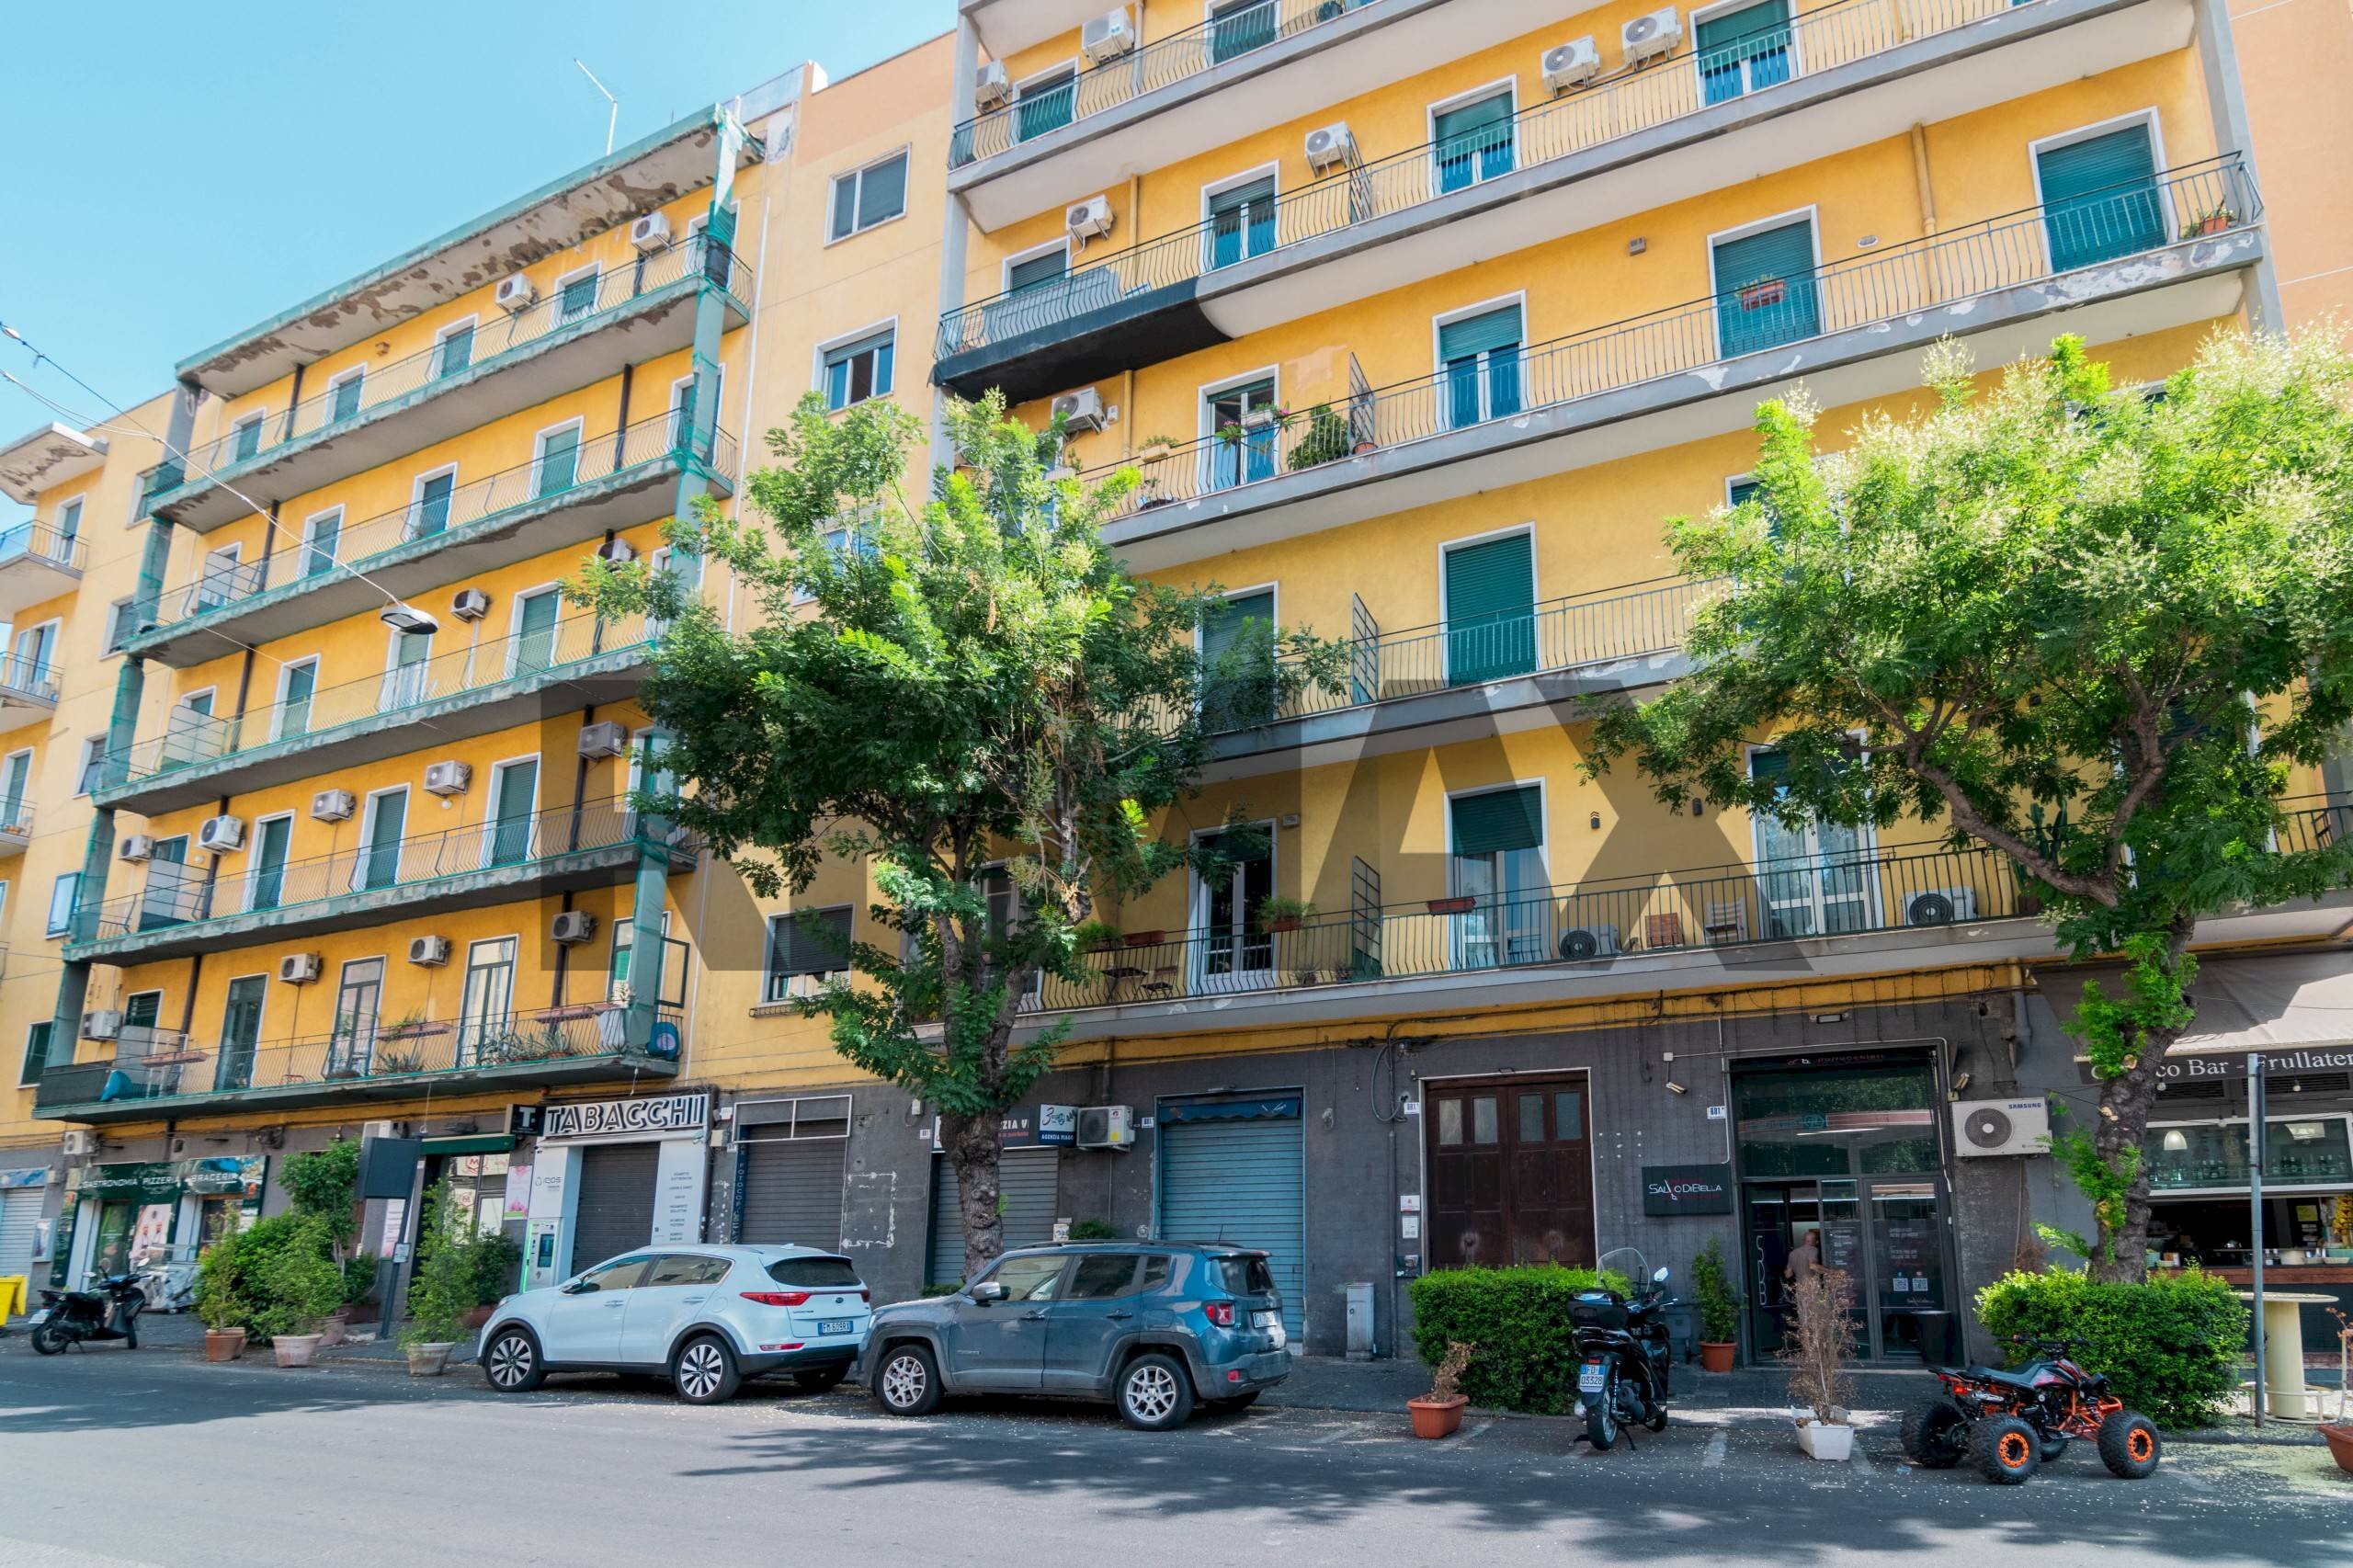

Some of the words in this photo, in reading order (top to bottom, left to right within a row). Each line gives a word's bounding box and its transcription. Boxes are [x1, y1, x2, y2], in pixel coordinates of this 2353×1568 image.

[2188, 1059, 2229, 1075] Bar
[2008, 1102, 2041, 1110] SAMSUNG
[547, 1096, 704, 1133] TABACCHI
